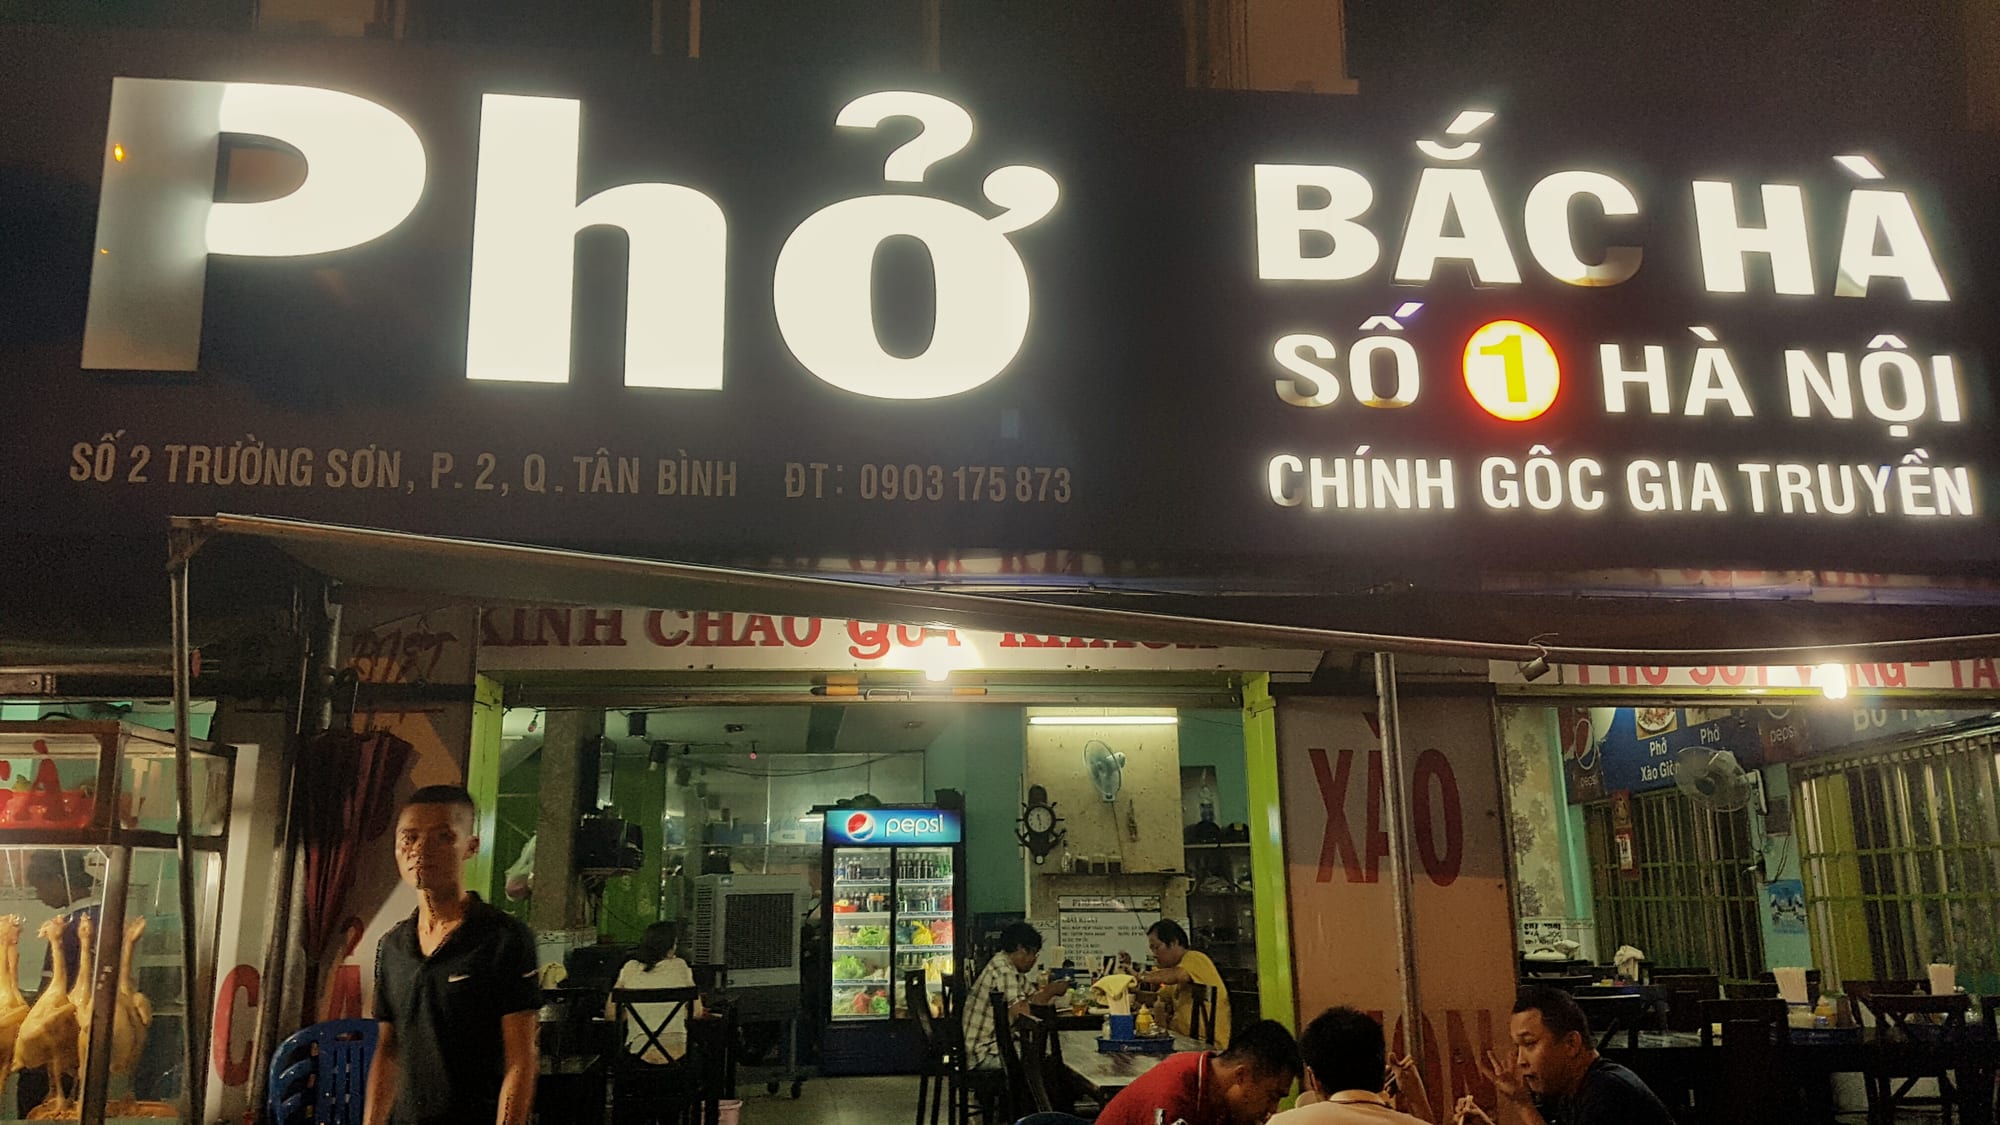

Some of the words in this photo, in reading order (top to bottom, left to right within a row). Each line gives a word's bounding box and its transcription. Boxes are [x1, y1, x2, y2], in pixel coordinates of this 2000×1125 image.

[81, 76, 1060, 400] Phở
[1254, 111, 1643, 286] BẮC
[1692, 156, 1951, 300] HÀ
[1273, 303, 1425, 408] SỐ
[1480, 335, 1528, 403] 1
[1599, 327, 1754, 417] HÀ
[1784, 334, 1961, 437] NỘI
[69, 429, 126, 482] SỐ
[128, 445, 152, 483] 2
[165, 433, 313, 486] TRƯỜNG
[326, 443, 414, 494] SƠN,
[431, 452, 463, 489] P.
[475, 453, 509, 497] 2,
[573, 447, 640, 494] TÂN
[658, 449, 737, 497] BÌNH
[784, 463, 843, 498] ĐT:
[860, 463, 944, 501] 0903
[1267, 446, 1456, 510] CHÍNH
[1627, 460, 1728, 513] GIA
[1738, 448, 1974, 515] TRUYỀN
[1640, 765, 1659, 782] Xào
[1650, 736, 1668, 757] Phở
[885, 814, 944, 838] pepsi
